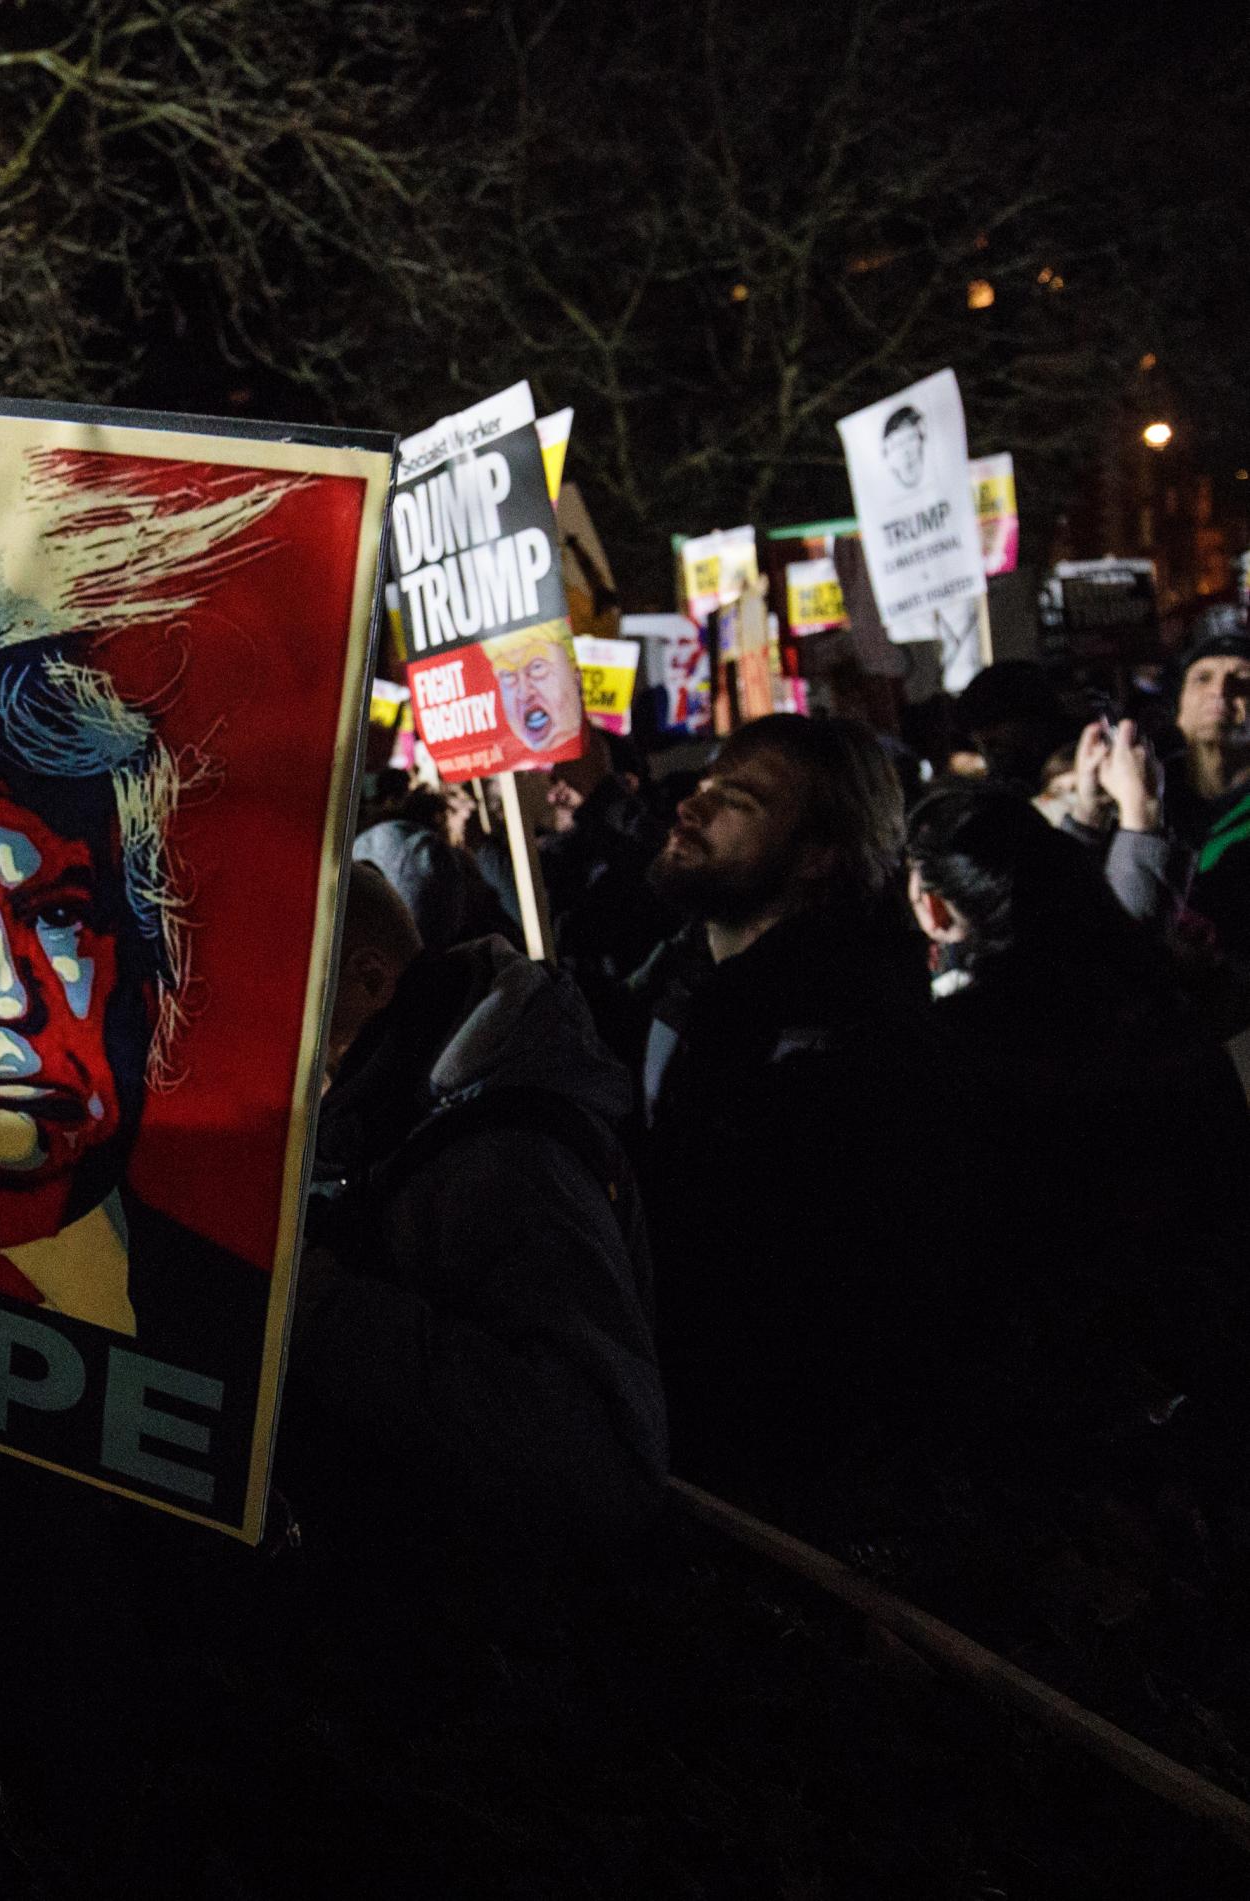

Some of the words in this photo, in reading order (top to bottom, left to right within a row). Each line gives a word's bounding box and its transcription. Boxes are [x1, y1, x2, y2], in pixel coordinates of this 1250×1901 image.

[393, 451, 511, 575] DUMP
[883, 499, 952, 547] TRUMP
[401, 527, 552, 651] TRUMP
[413, 660, 466, 709] FIGHT
[420, 689, 498, 744] BIGOTRY
